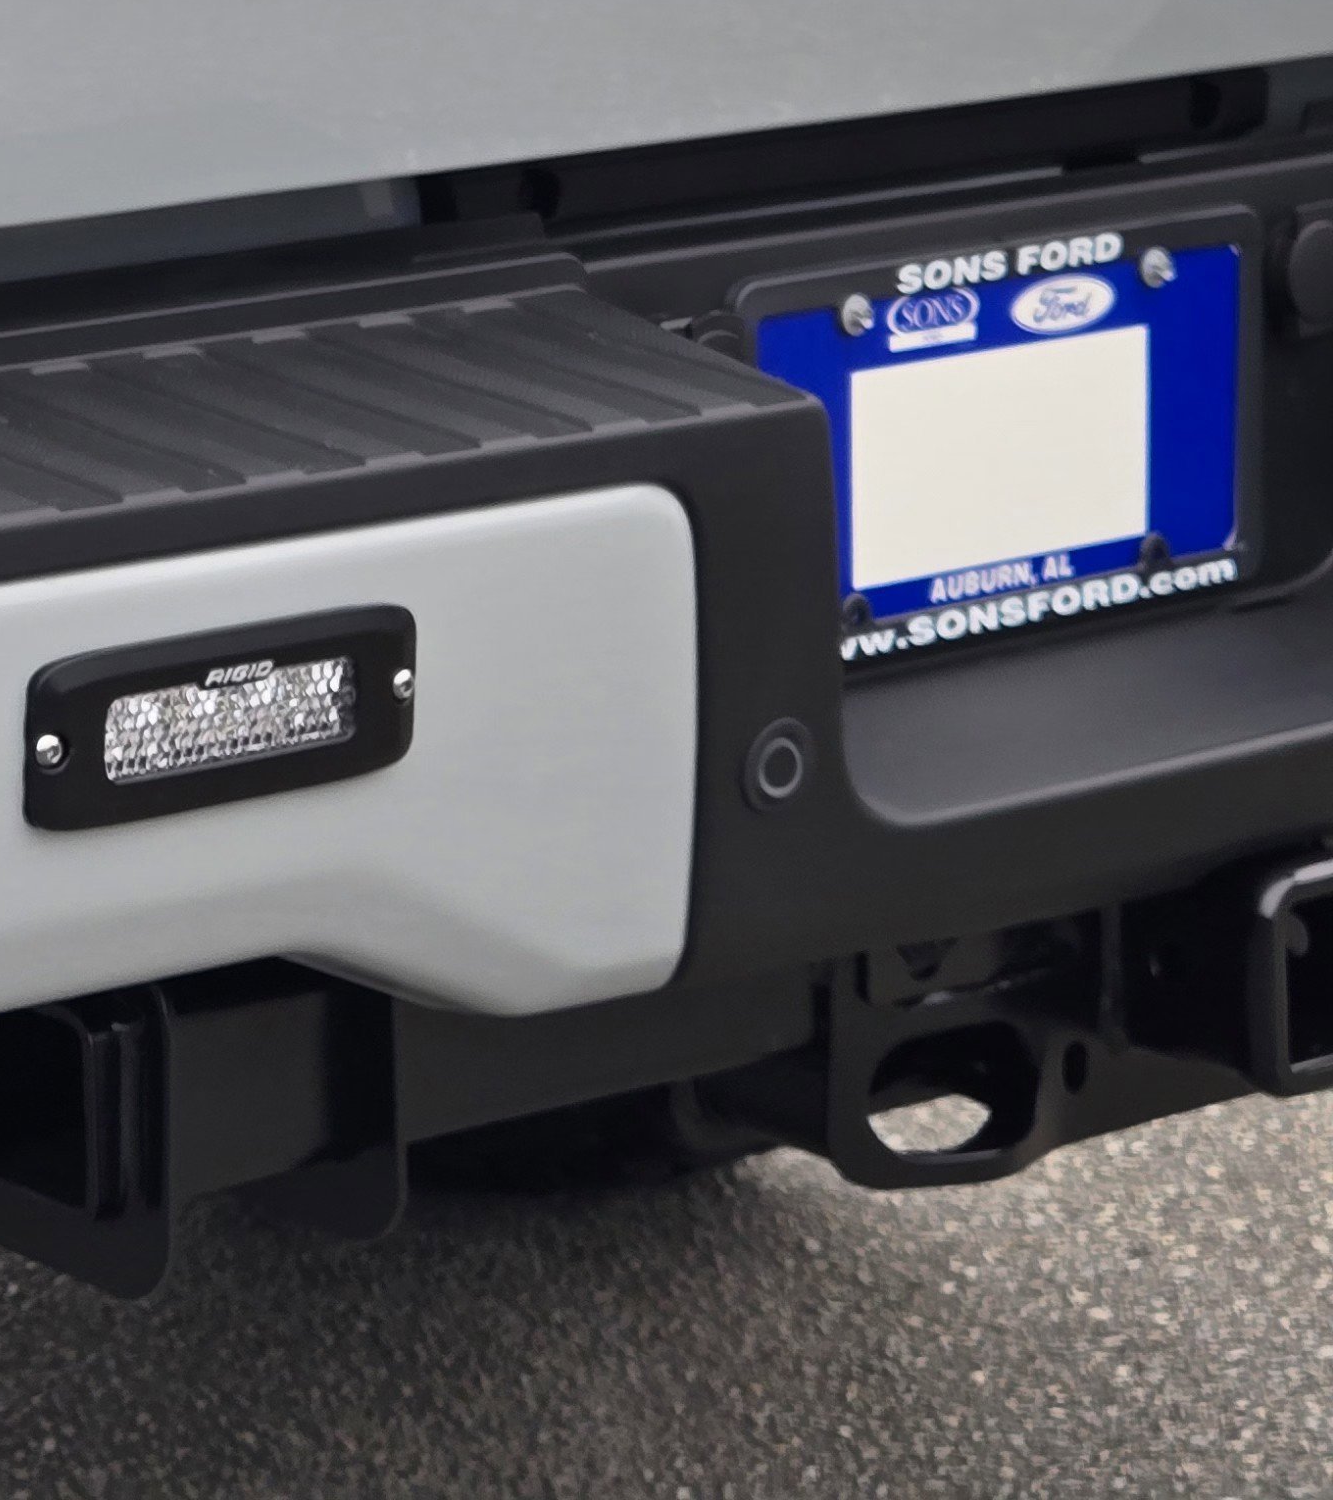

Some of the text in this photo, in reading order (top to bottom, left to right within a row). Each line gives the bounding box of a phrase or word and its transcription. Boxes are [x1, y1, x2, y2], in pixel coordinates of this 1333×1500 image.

[895, 232, 1124, 296] SONS FORD
[900, 293, 967, 332] SONS
[1033, 286, 1093, 324] Ford
[930, 553, 1076, 604] AUBURN, AL
[203, 659, 274, 688] RIGID
